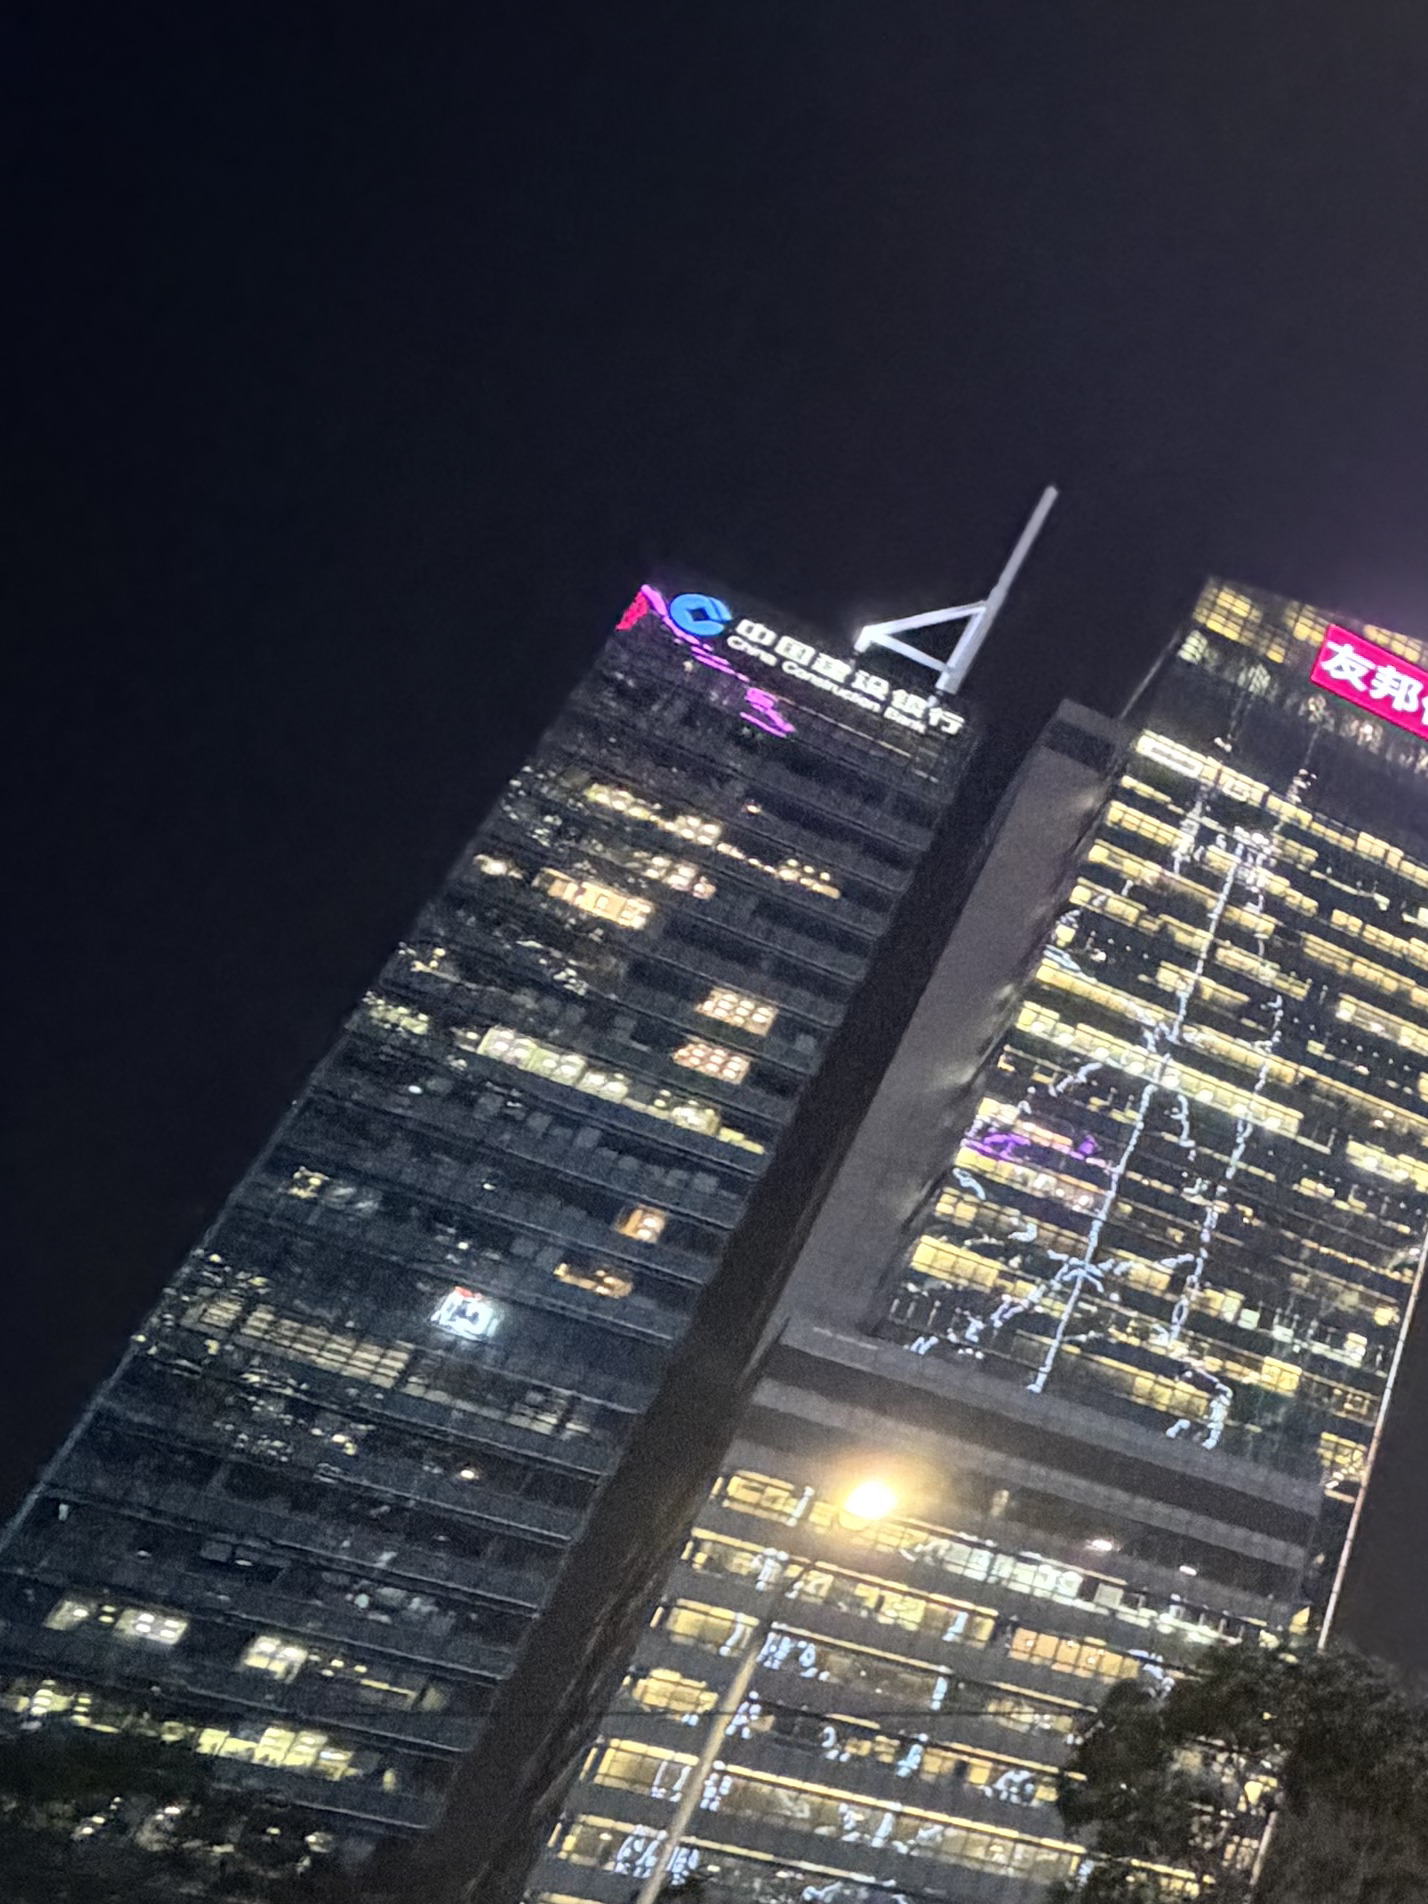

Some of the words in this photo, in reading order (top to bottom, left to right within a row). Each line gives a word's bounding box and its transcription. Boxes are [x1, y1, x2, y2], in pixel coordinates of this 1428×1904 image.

[727, 635, 777, 666] China
[782, 661, 881, 712] Construction
[883, 706, 926, 734] Bank
